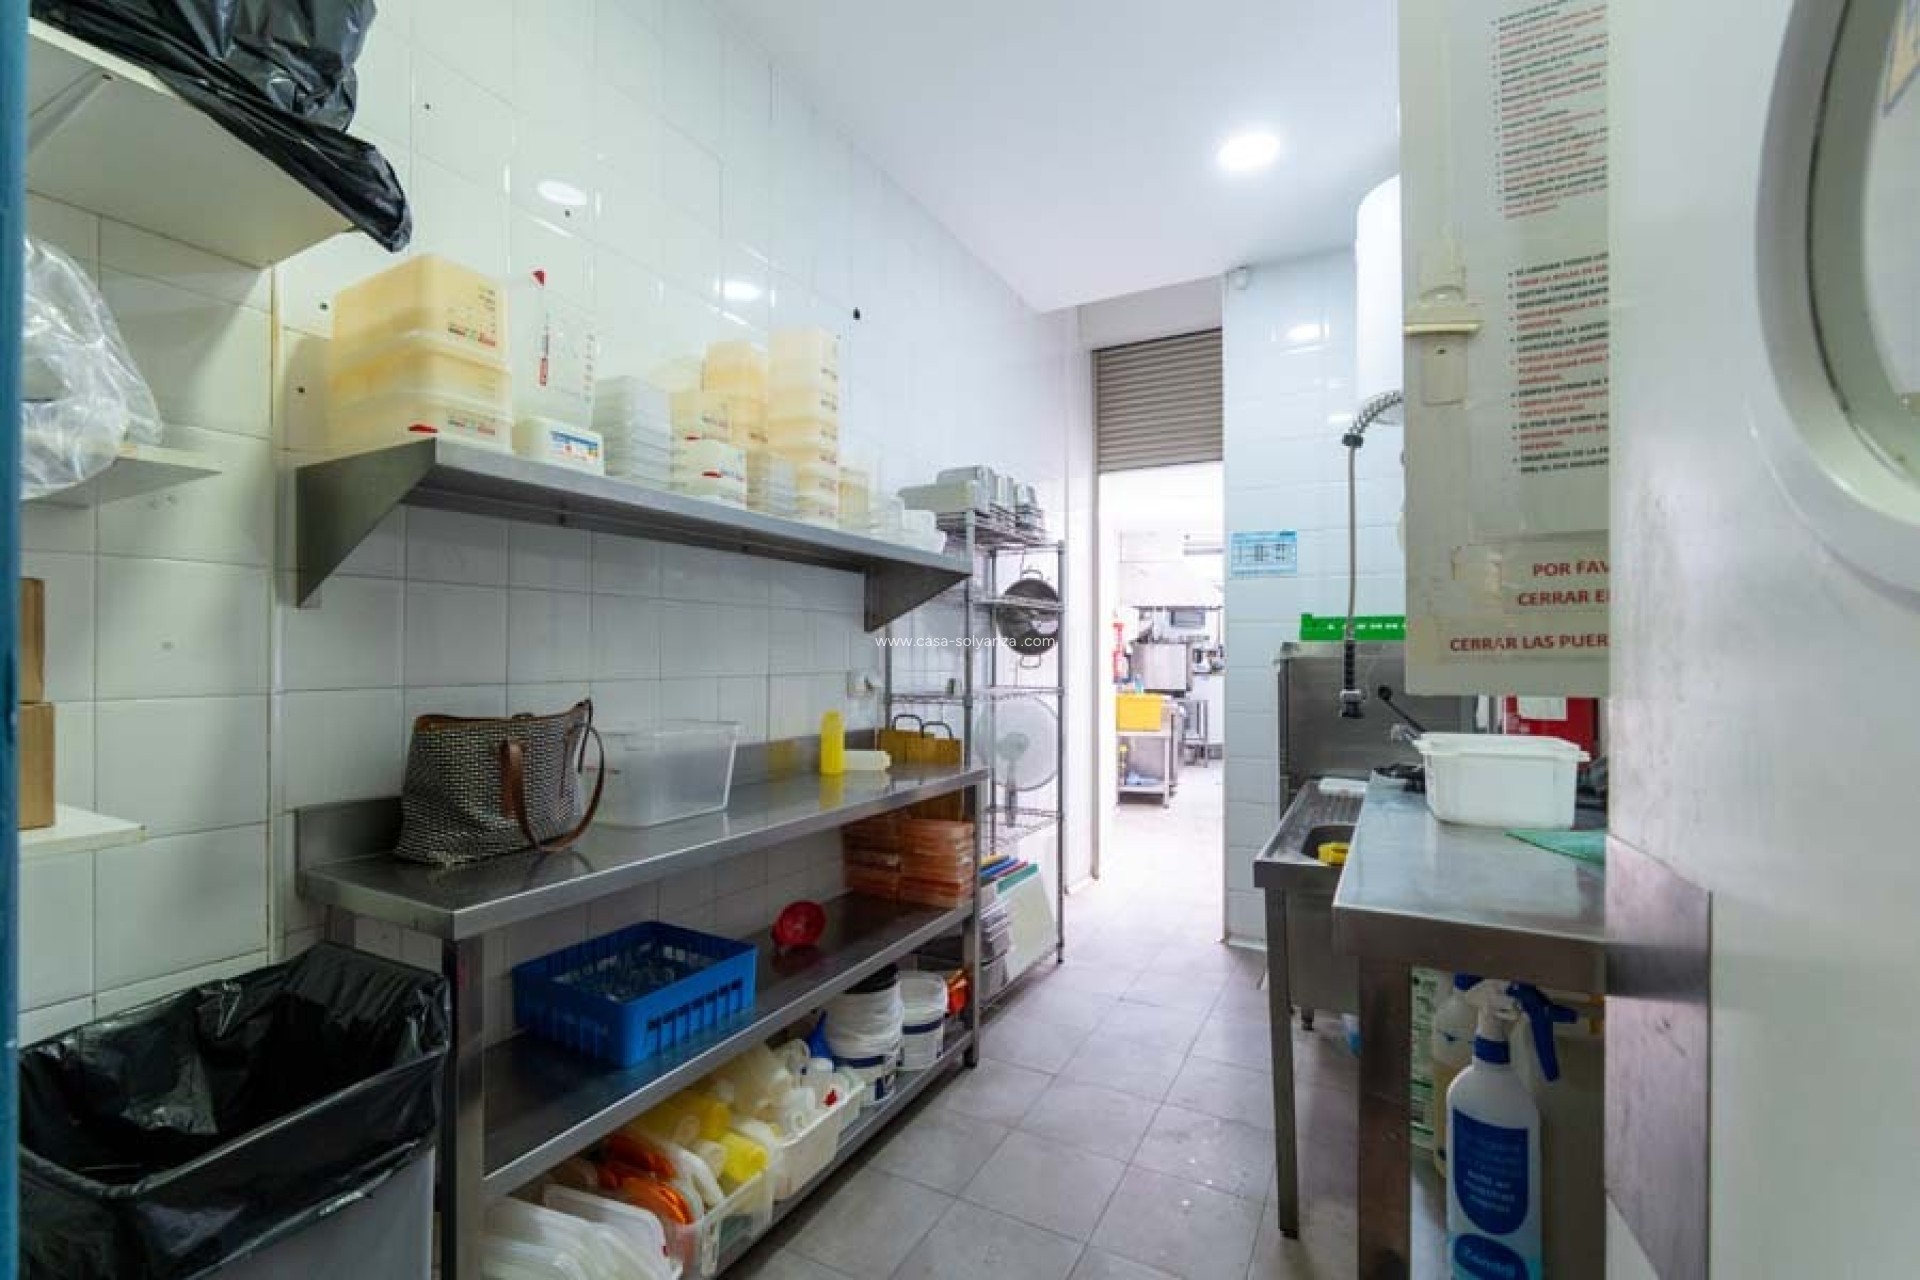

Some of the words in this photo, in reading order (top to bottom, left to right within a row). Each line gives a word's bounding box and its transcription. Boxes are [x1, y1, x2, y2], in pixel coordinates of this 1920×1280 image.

[1533, 562, 1571, 577] POR
[1518, 590, 1588, 607] CERRAR
[1450, 636, 1517, 651] CERRAR
[1522, 635, 1554, 649] LAS
[1559, 633, 1609, 648] PUER
